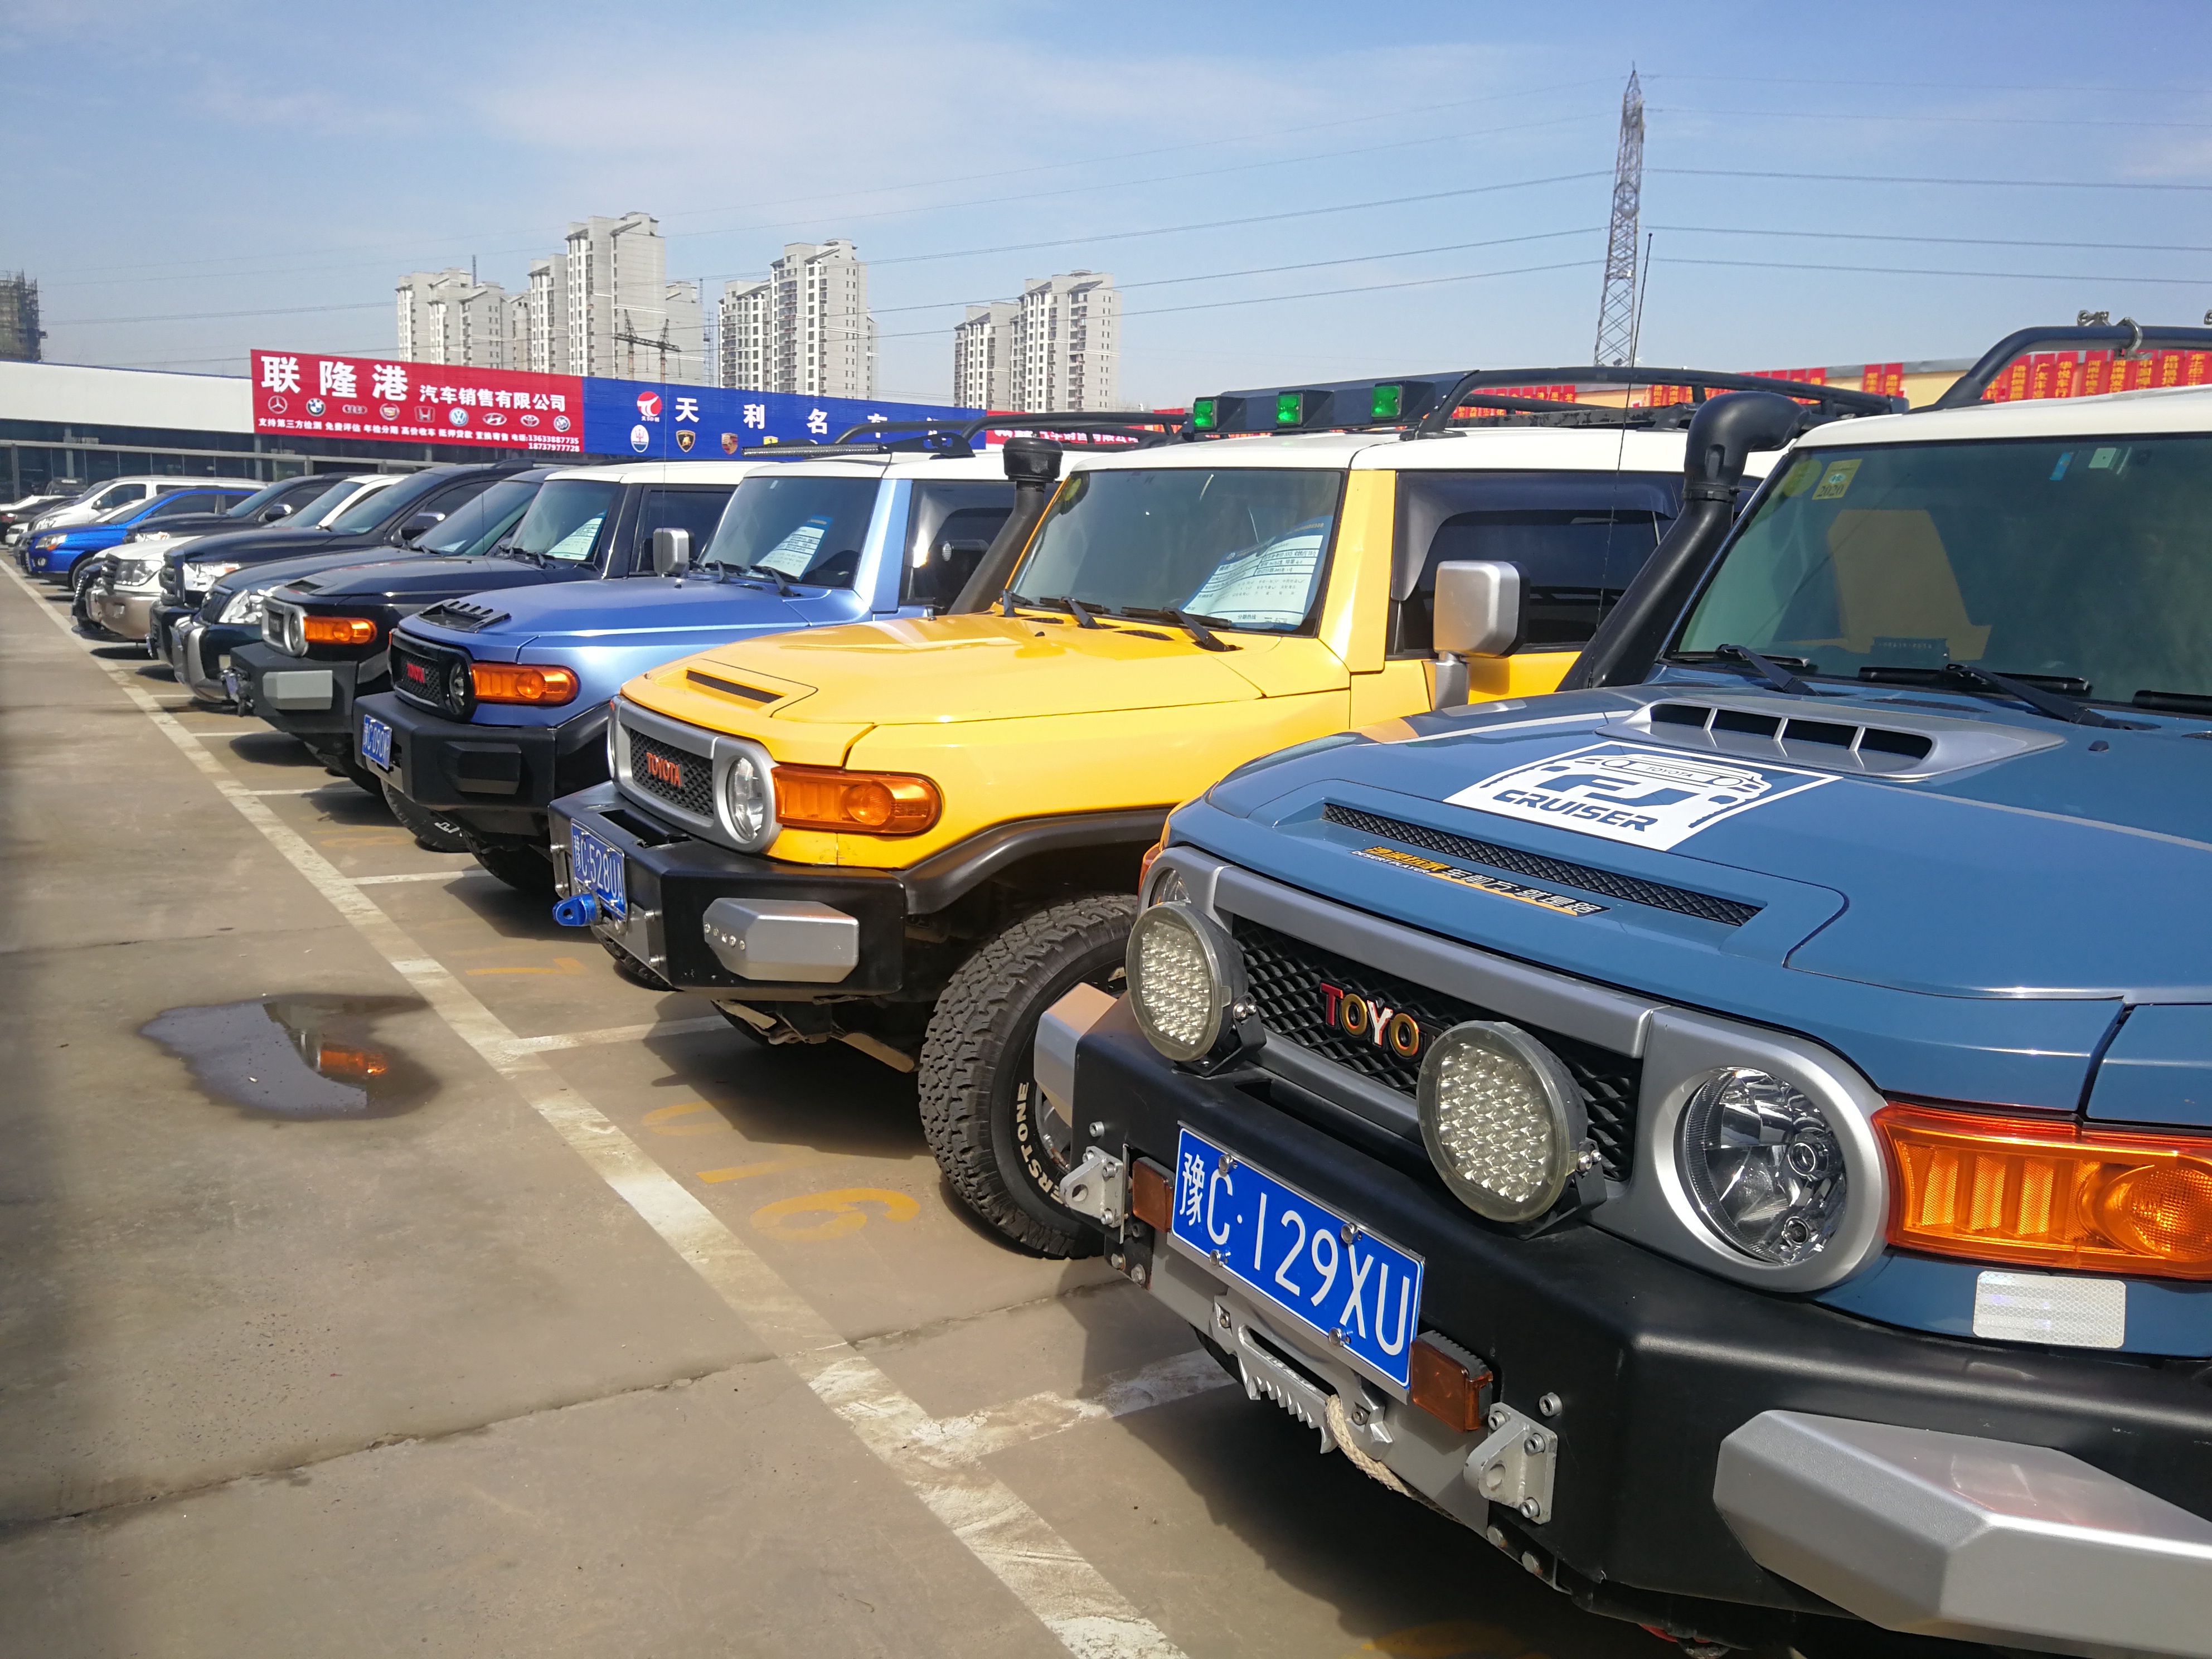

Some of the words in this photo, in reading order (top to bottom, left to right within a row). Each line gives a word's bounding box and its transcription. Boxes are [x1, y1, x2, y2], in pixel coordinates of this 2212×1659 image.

[261, 356, 409, 401] 联隆港
[419, 385, 566, 411] 汽车销售有限公司
[258, 418, 322, 430] 支持第三方检测
[325, 422, 361, 432] 免费评估
[363, 424, 399, 434] 年检分期
[401, 426, 436, 436] 高价收车
[439, 429, 473, 439] 抵押贷款
[1817, 484, 1845, 497] 2020
[646, 752, 681, 787] TOYOTA
[1646, 766, 1694, 778] TOYOTA
[1492, 789, 1658, 832] CRUISER
[1352, 850, 1390, 864] DESERT
[1390, 859, 1430, 874] PLAYER
[1365, 846, 1451, 871] 沙漠玩家
